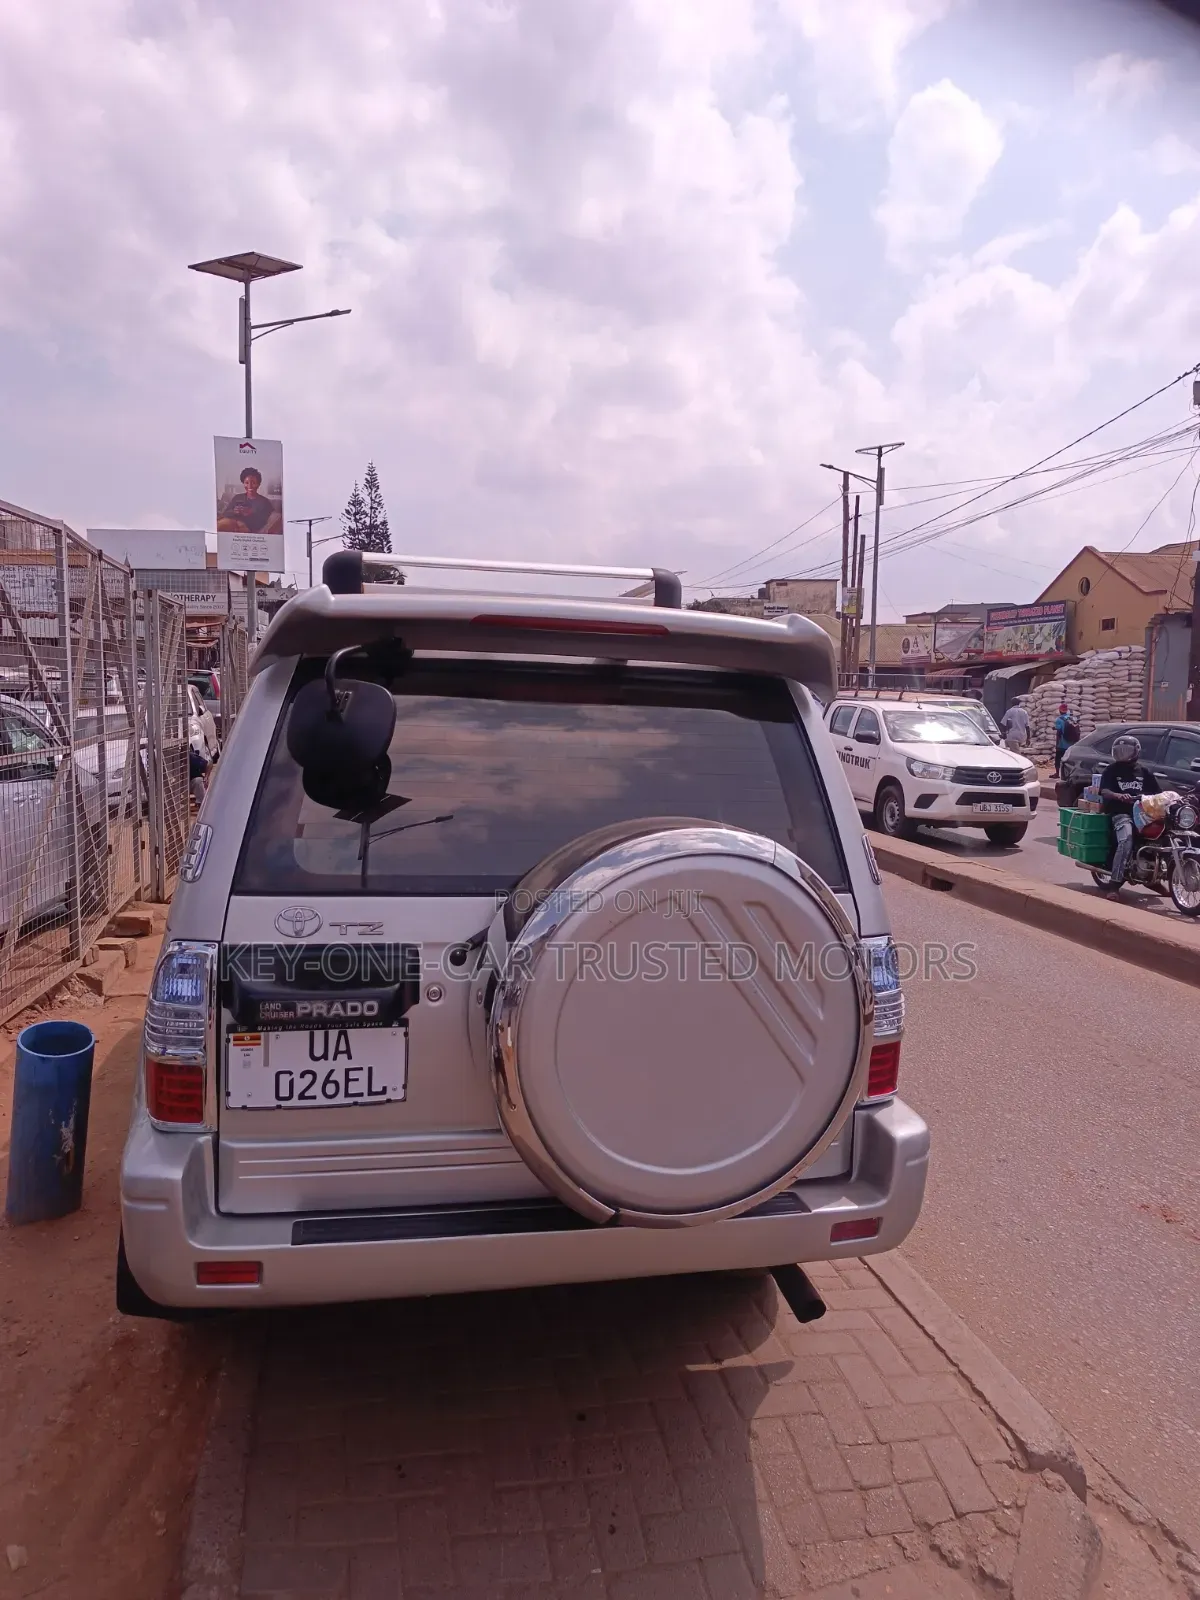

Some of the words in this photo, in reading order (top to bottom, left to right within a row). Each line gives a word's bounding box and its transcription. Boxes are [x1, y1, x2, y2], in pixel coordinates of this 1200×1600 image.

[836, 750, 871, 770] INOTRUK
[329, 921, 385, 936] TZ
[260, 1002, 281, 1010] LAND
[296, 1001, 379, 1017] PRADO
[260, 1011, 294, 1019] CRUISER
[257, 1024, 283, 1032] Making
[363, 1020, 384, 1028] Space
[308, 1029, 353, 1062] UA
[274, 1065, 388, 1102] 026EL
